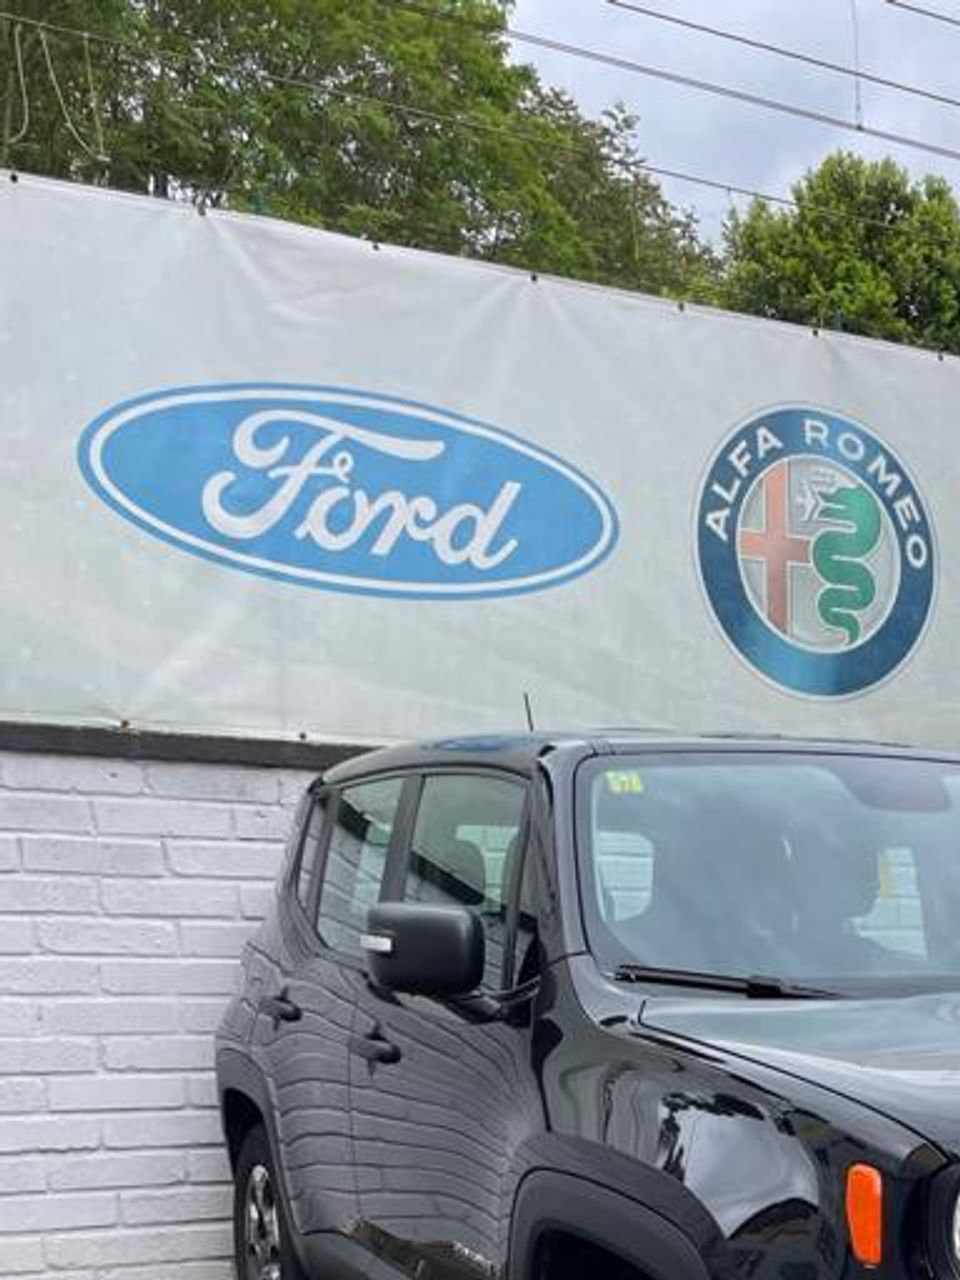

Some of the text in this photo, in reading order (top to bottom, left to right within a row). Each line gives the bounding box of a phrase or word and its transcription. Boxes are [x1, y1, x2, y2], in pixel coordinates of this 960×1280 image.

[201, 409, 520, 569] Ford
[705, 419, 928, 569] ALFA ROMEO
